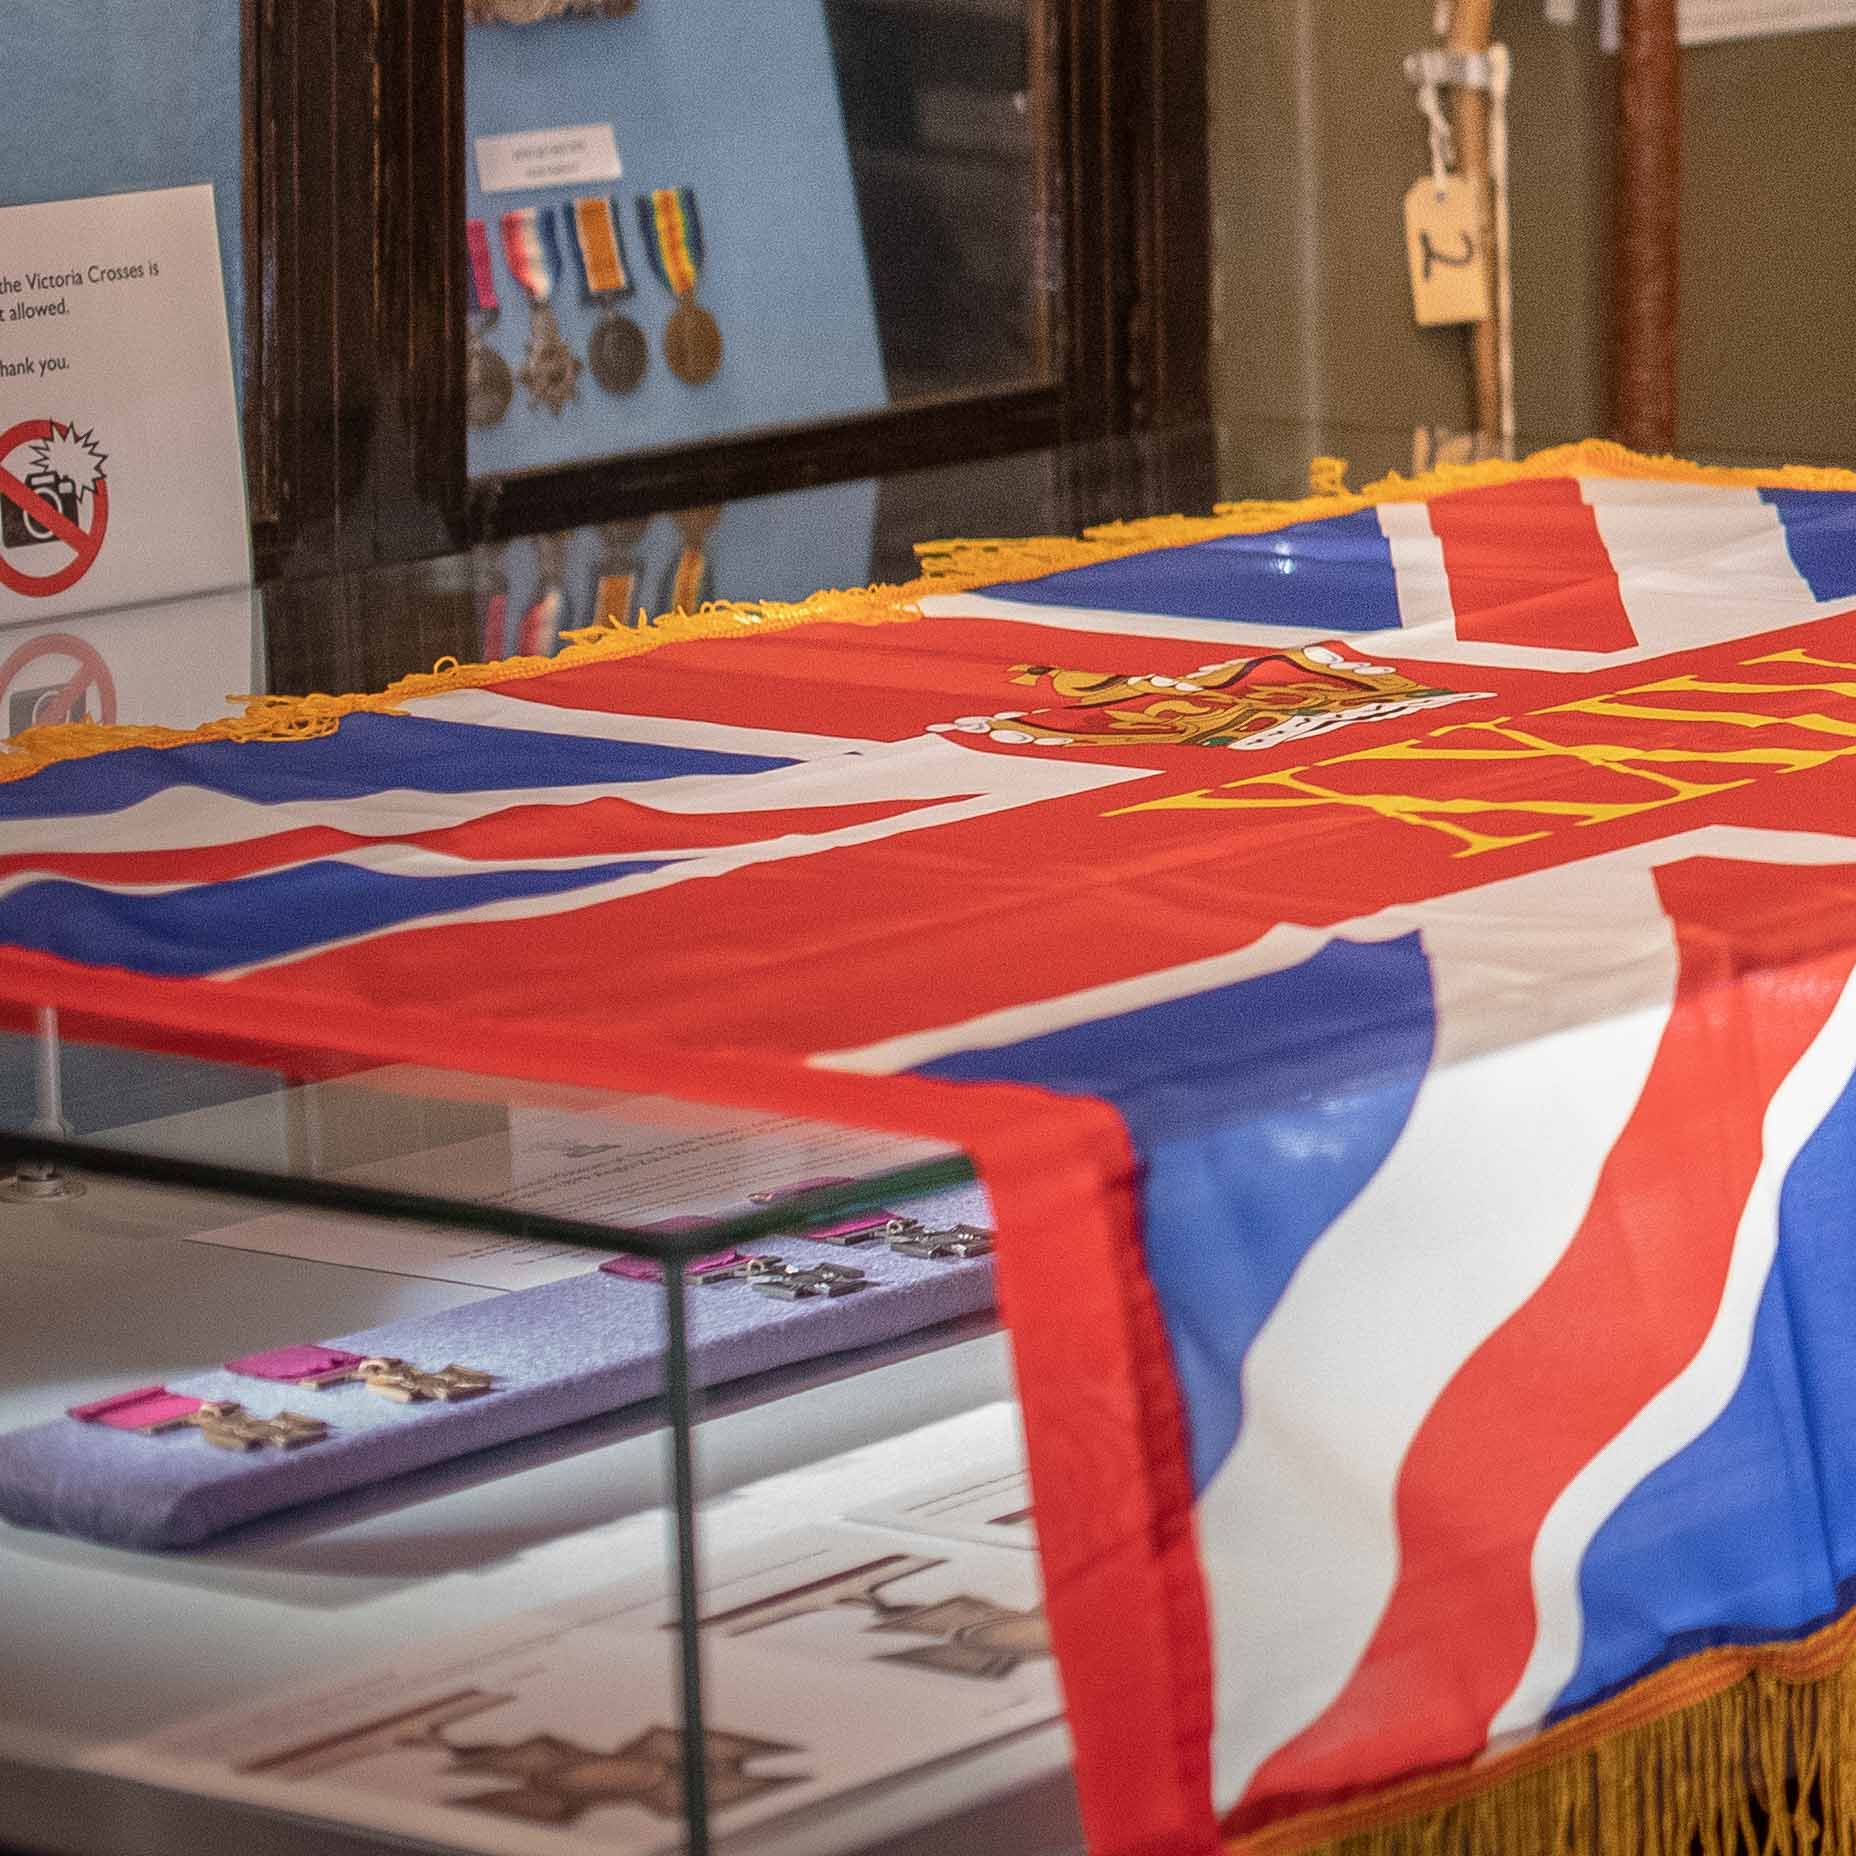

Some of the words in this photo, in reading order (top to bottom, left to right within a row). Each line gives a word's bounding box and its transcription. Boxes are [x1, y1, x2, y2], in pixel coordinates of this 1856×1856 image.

[25, 269, 83, 290] Victoria
[88, 264, 144, 283] Crosses
[149, 261, 159, 276] is
[10, 298, 69, 321] allowed.
[39, 357, 69, 377] you.
